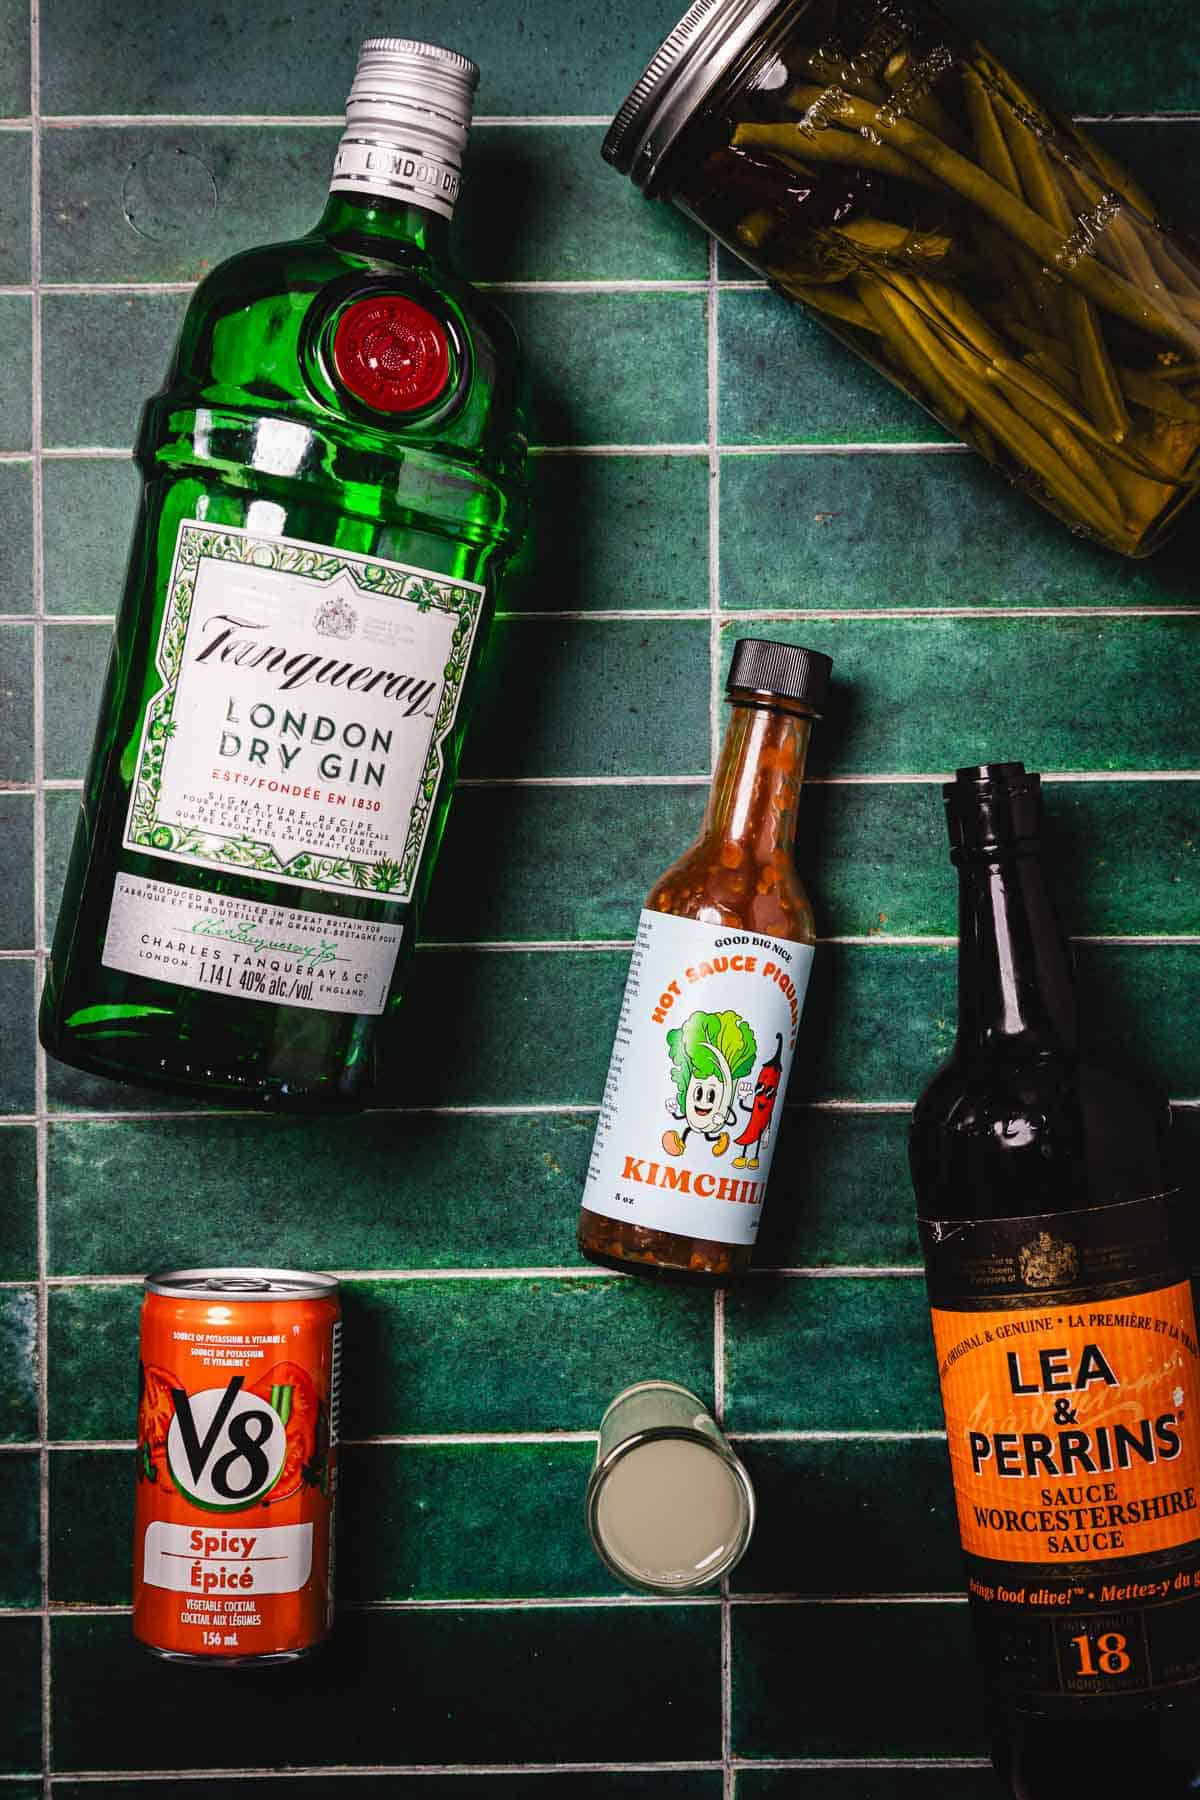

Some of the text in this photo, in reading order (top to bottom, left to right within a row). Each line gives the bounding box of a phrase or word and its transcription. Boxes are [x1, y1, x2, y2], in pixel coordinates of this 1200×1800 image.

[195, 614, 438, 717] Tanqueray
[226, 696, 393, 754] LONDON
[219, 731, 386, 788] DRY GIN
[208, 791, 374, 832] SIGNATURE RECIPE
[327, 793, 347, 805] EN
[352, 798, 381, 812] 1830
[198, 806, 375, 849] RECETTE SIGNATURE
[146, 883, 202, 902] PRODUCED
[219, 900, 268, 916] BOTTLED
[273, 910, 285, 918] IN
[289, 913, 322, 924] GREAT
[140, 934, 222, 960] CHARLES
[233, 953, 336, 981] TANQUERAY
[341, 971, 349, 982] &
[714, 935, 793, 964] GOOD BIG NICE
[199, 961, 314, 1001] 1.14 L 40% alc./vol.
[651, 980, 683, 1025] HOT
[684, 954, 758, 984] SAUCE
[946, 1333, 984, 1368] ORIGINAL
[984, 1330, 995, 1343] &
[995, 1317, 1055, 1339] GENUINE
[1068, 1314, 1086, 1328] LA
[1088, 1311, 1152, 1331] PREMIÈRE
[1153, 1319, 1169, 1334] ET
[1168, 1325, 1180, 1341] LA
[1006, 1342, 1121, 1398] LEA
[1053, 1397, 1080, 1425] &
[171, 1376, 274, 1500] V8
[969, 1412, 1184, 1479] PERRINS
[972, 1487, 1199, 1533] WORCESTERSHIRE
[1041, 1483, 1119, 1506] SAUCE
[190, 1530, 257, 1558] Spicy
[1047, 1530, 1125, 1554] SAUCE
[190, 1560, 255, 1594] Épicé
[996, 1585, 1025, 1604] food
[1099, 1579, 1171, 1603] Mettez-y
[1173, 1570, 1191, 1590] du
[180, 1611, 262, 1626] COCKTAIL AUX LÉGUMES
[185, 1598, 257, 1612] VEGETABLE COCKTAIL
[202, 1631, 222, 1646] 156
[1071, 1632, 1132, 1676] 18
